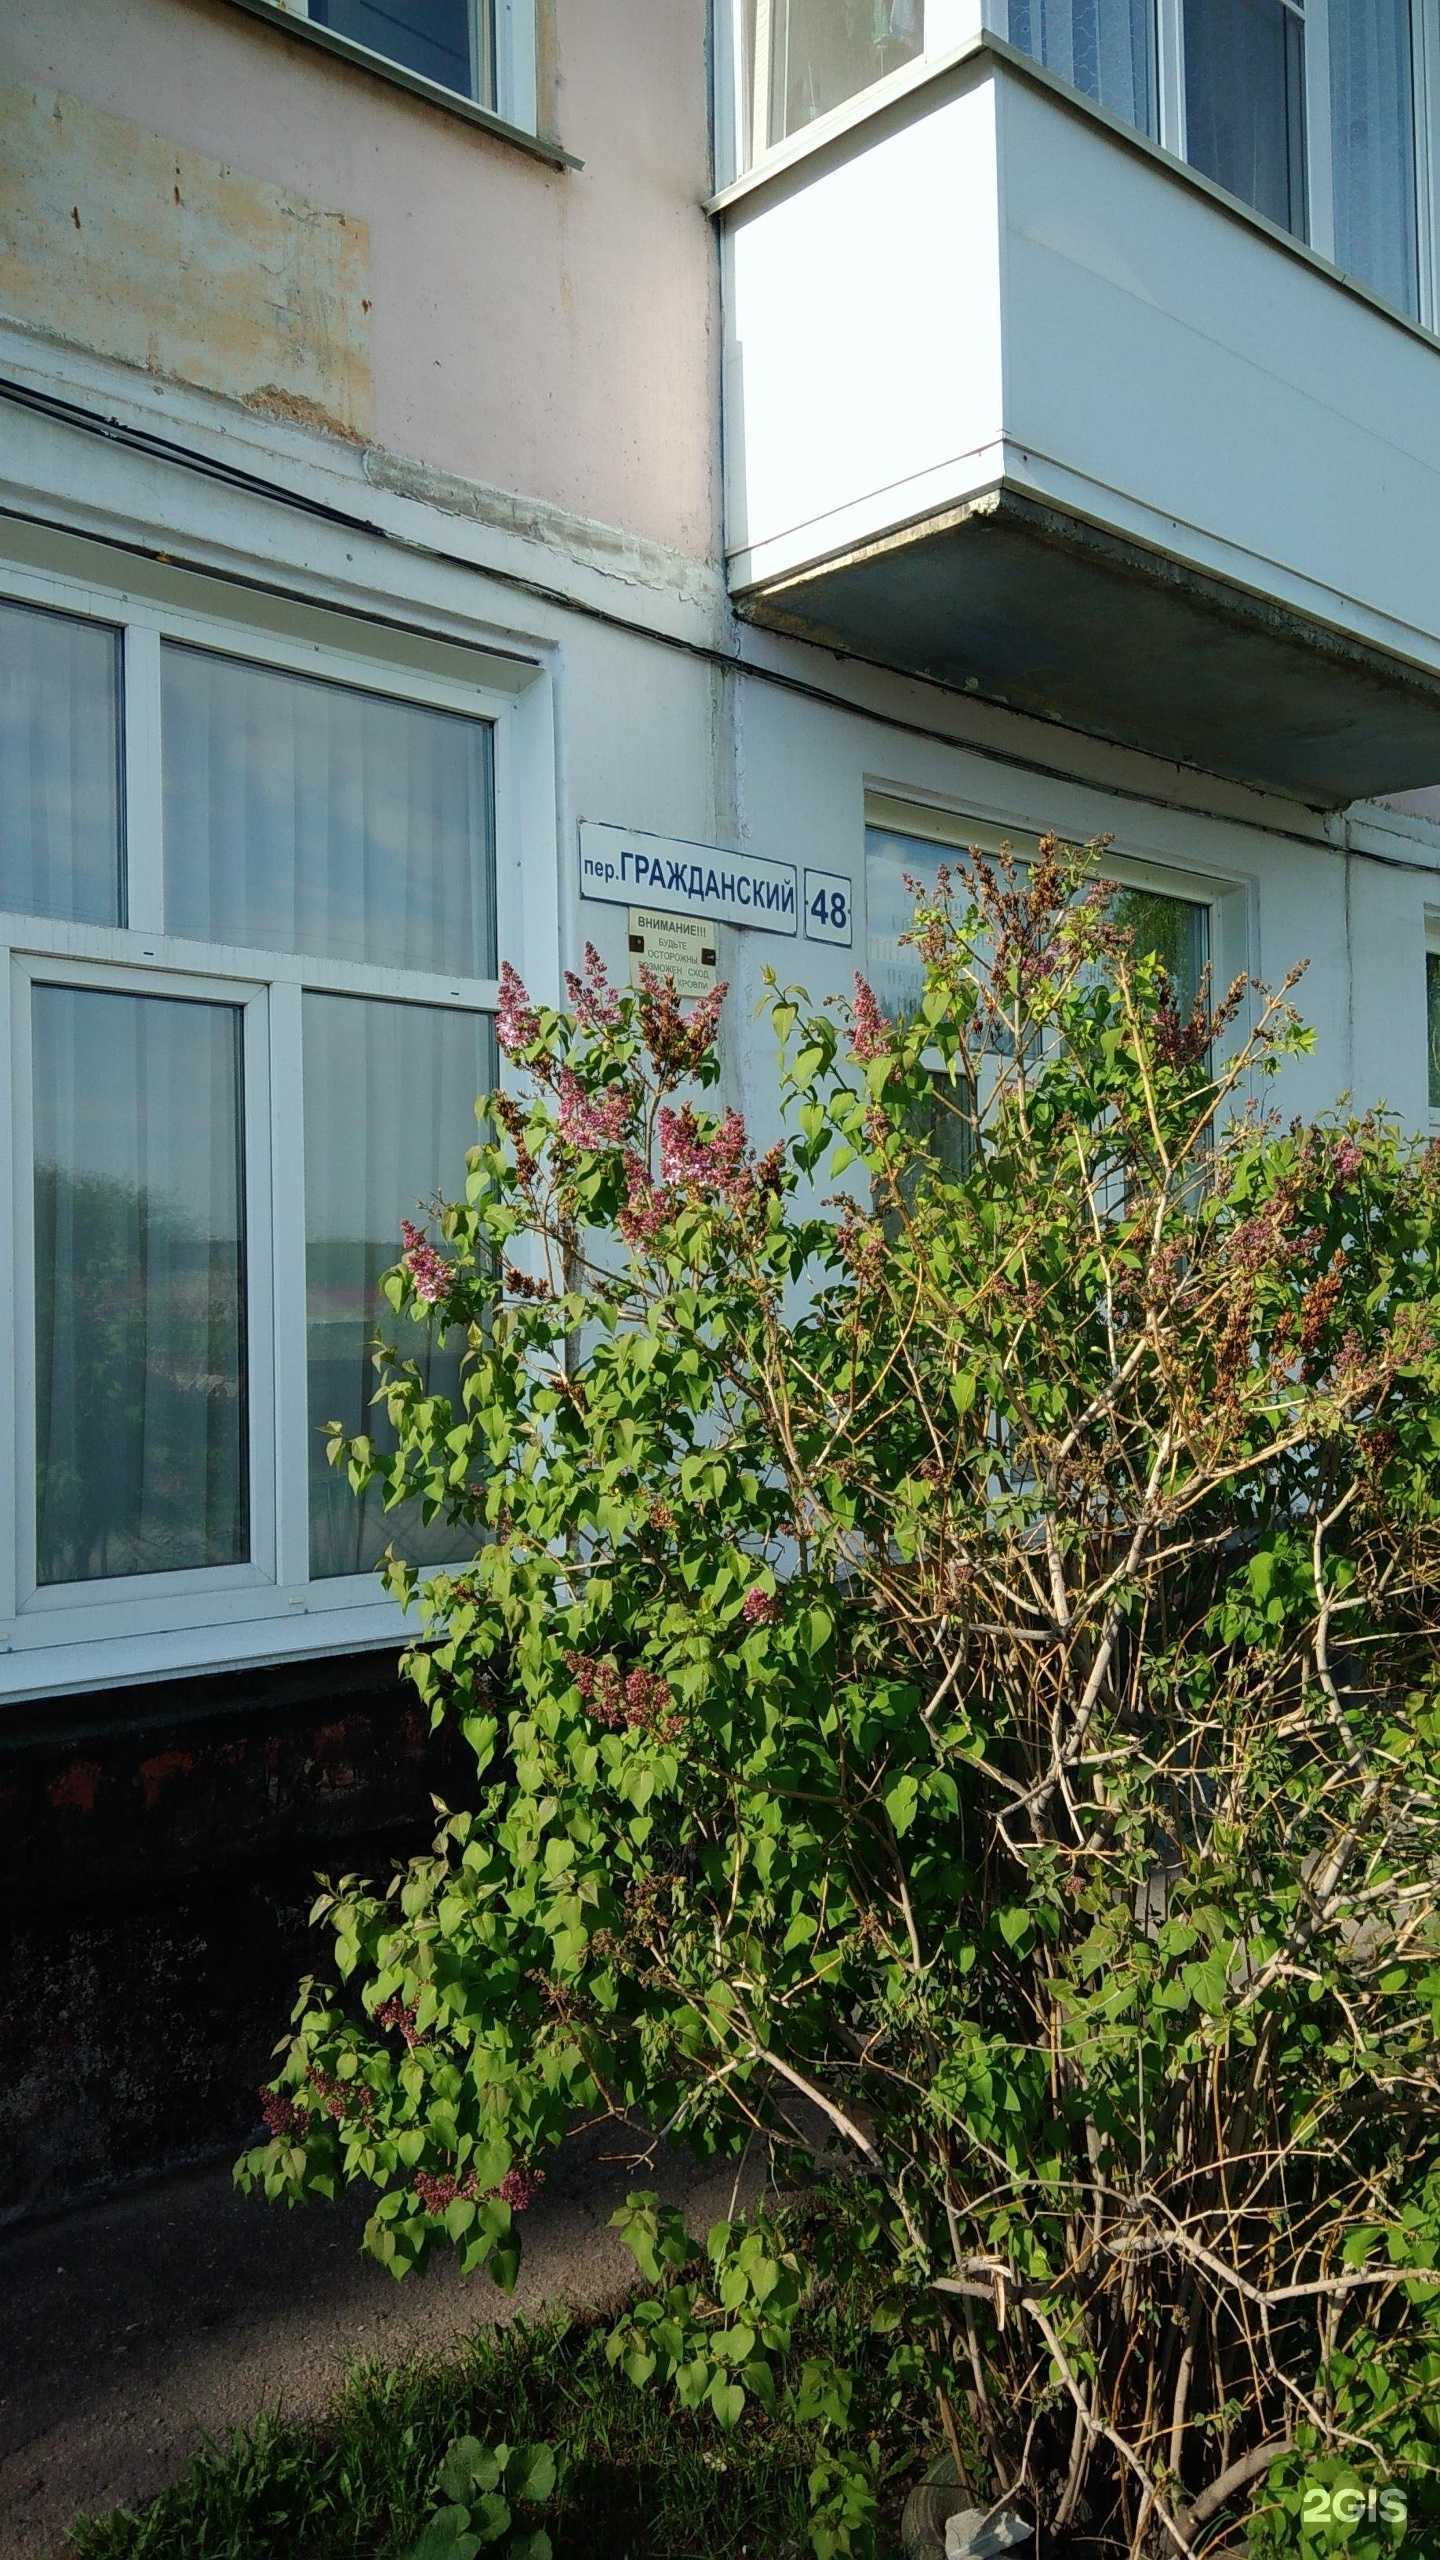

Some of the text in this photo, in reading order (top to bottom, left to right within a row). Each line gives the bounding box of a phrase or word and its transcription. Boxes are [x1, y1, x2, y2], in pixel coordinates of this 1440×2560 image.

[811, 889, 847, 929] 48
[638, 916, 706, 938] ВНИМАНИЕ!!!
[658, 937, 687, 950] БУДЬТЕ
[647, 949, 698, 964] ОСТОРОЖНЫ
[688, 967, 709, 979] СХОД
